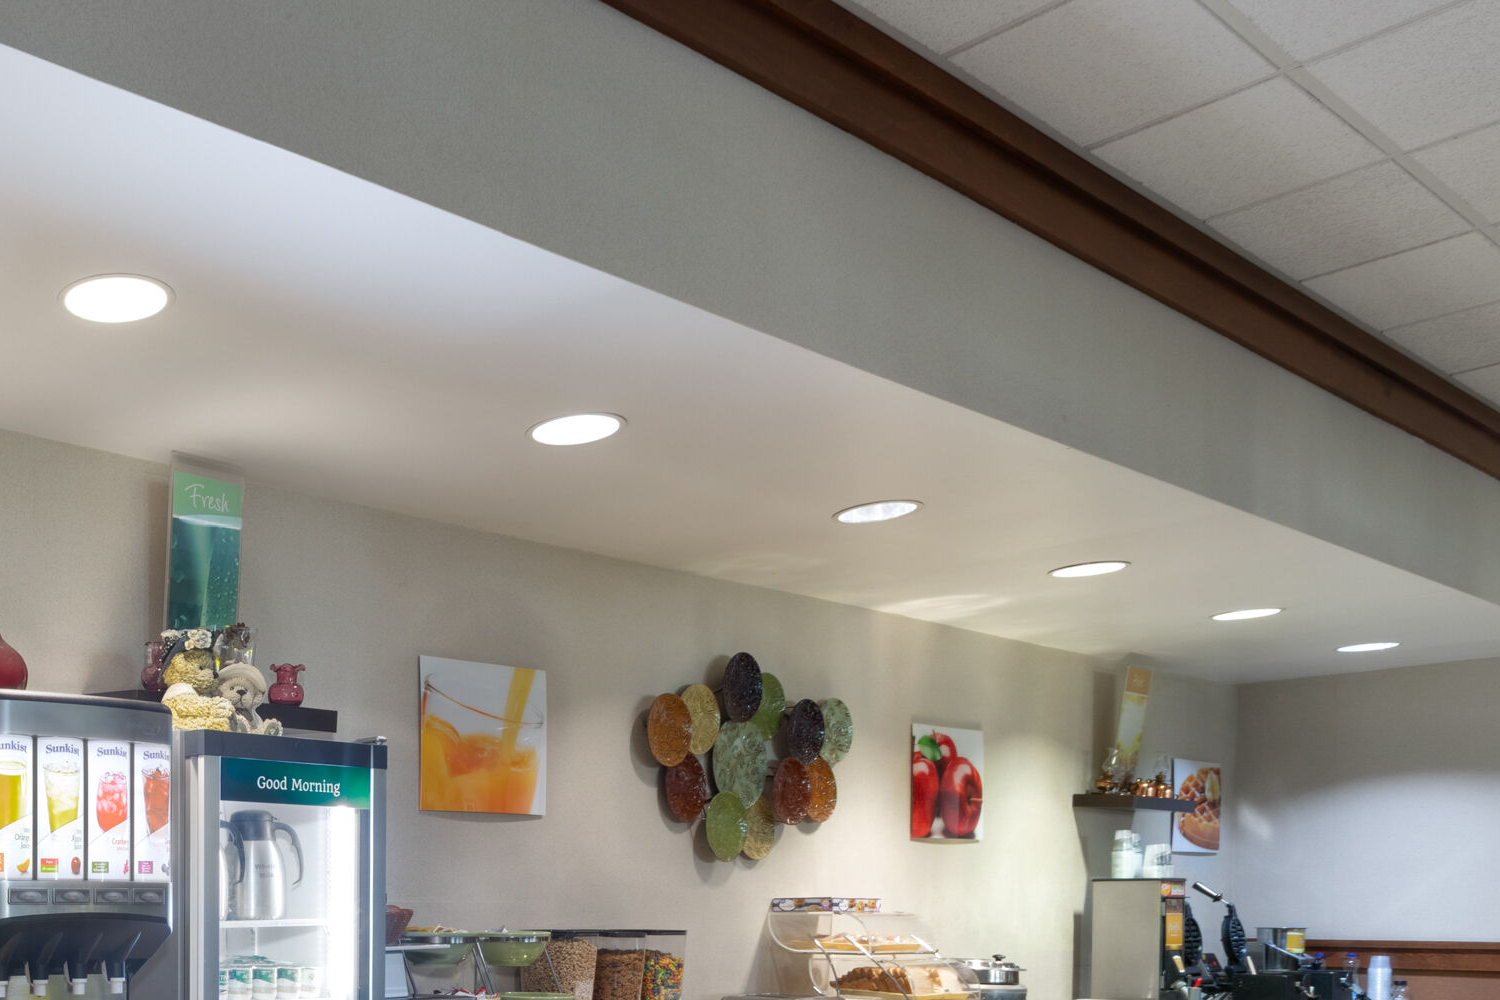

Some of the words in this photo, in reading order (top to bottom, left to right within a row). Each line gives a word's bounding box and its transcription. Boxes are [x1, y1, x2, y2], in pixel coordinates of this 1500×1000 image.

[184, 483, 230, 513] Fresh
[256, 776, 288, 791] Good
[291, 778, 341, 797] Morning
